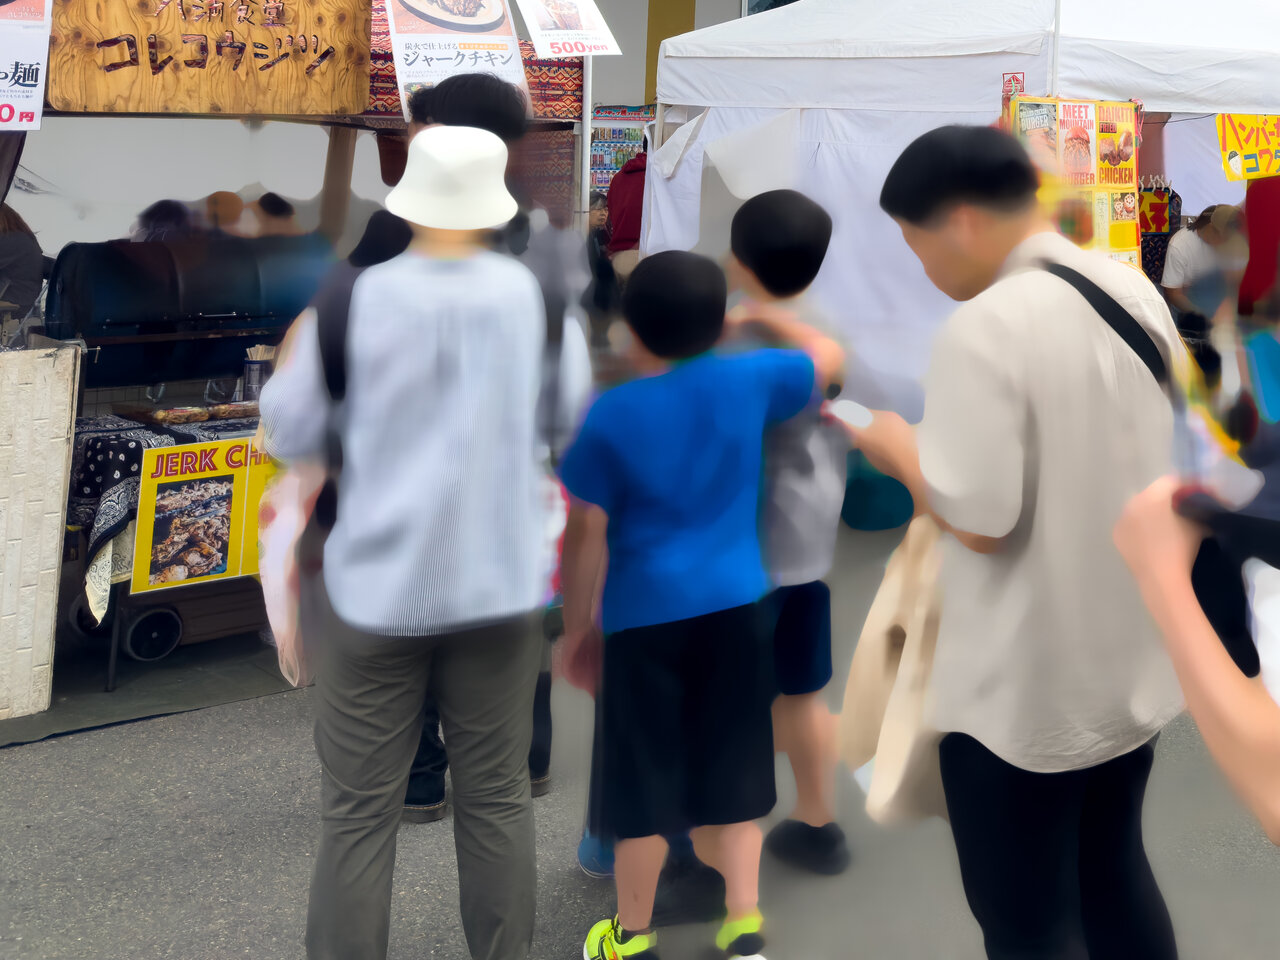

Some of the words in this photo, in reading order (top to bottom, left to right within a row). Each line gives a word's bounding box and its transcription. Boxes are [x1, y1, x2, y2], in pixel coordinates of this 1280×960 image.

[403, 50, 514, 68] ジャークチキン
[1062, 104, 1090, 120] MEET
[1098, 167, 1134, 185] CHICKEN
[150, 447, 219, 479] JERK
